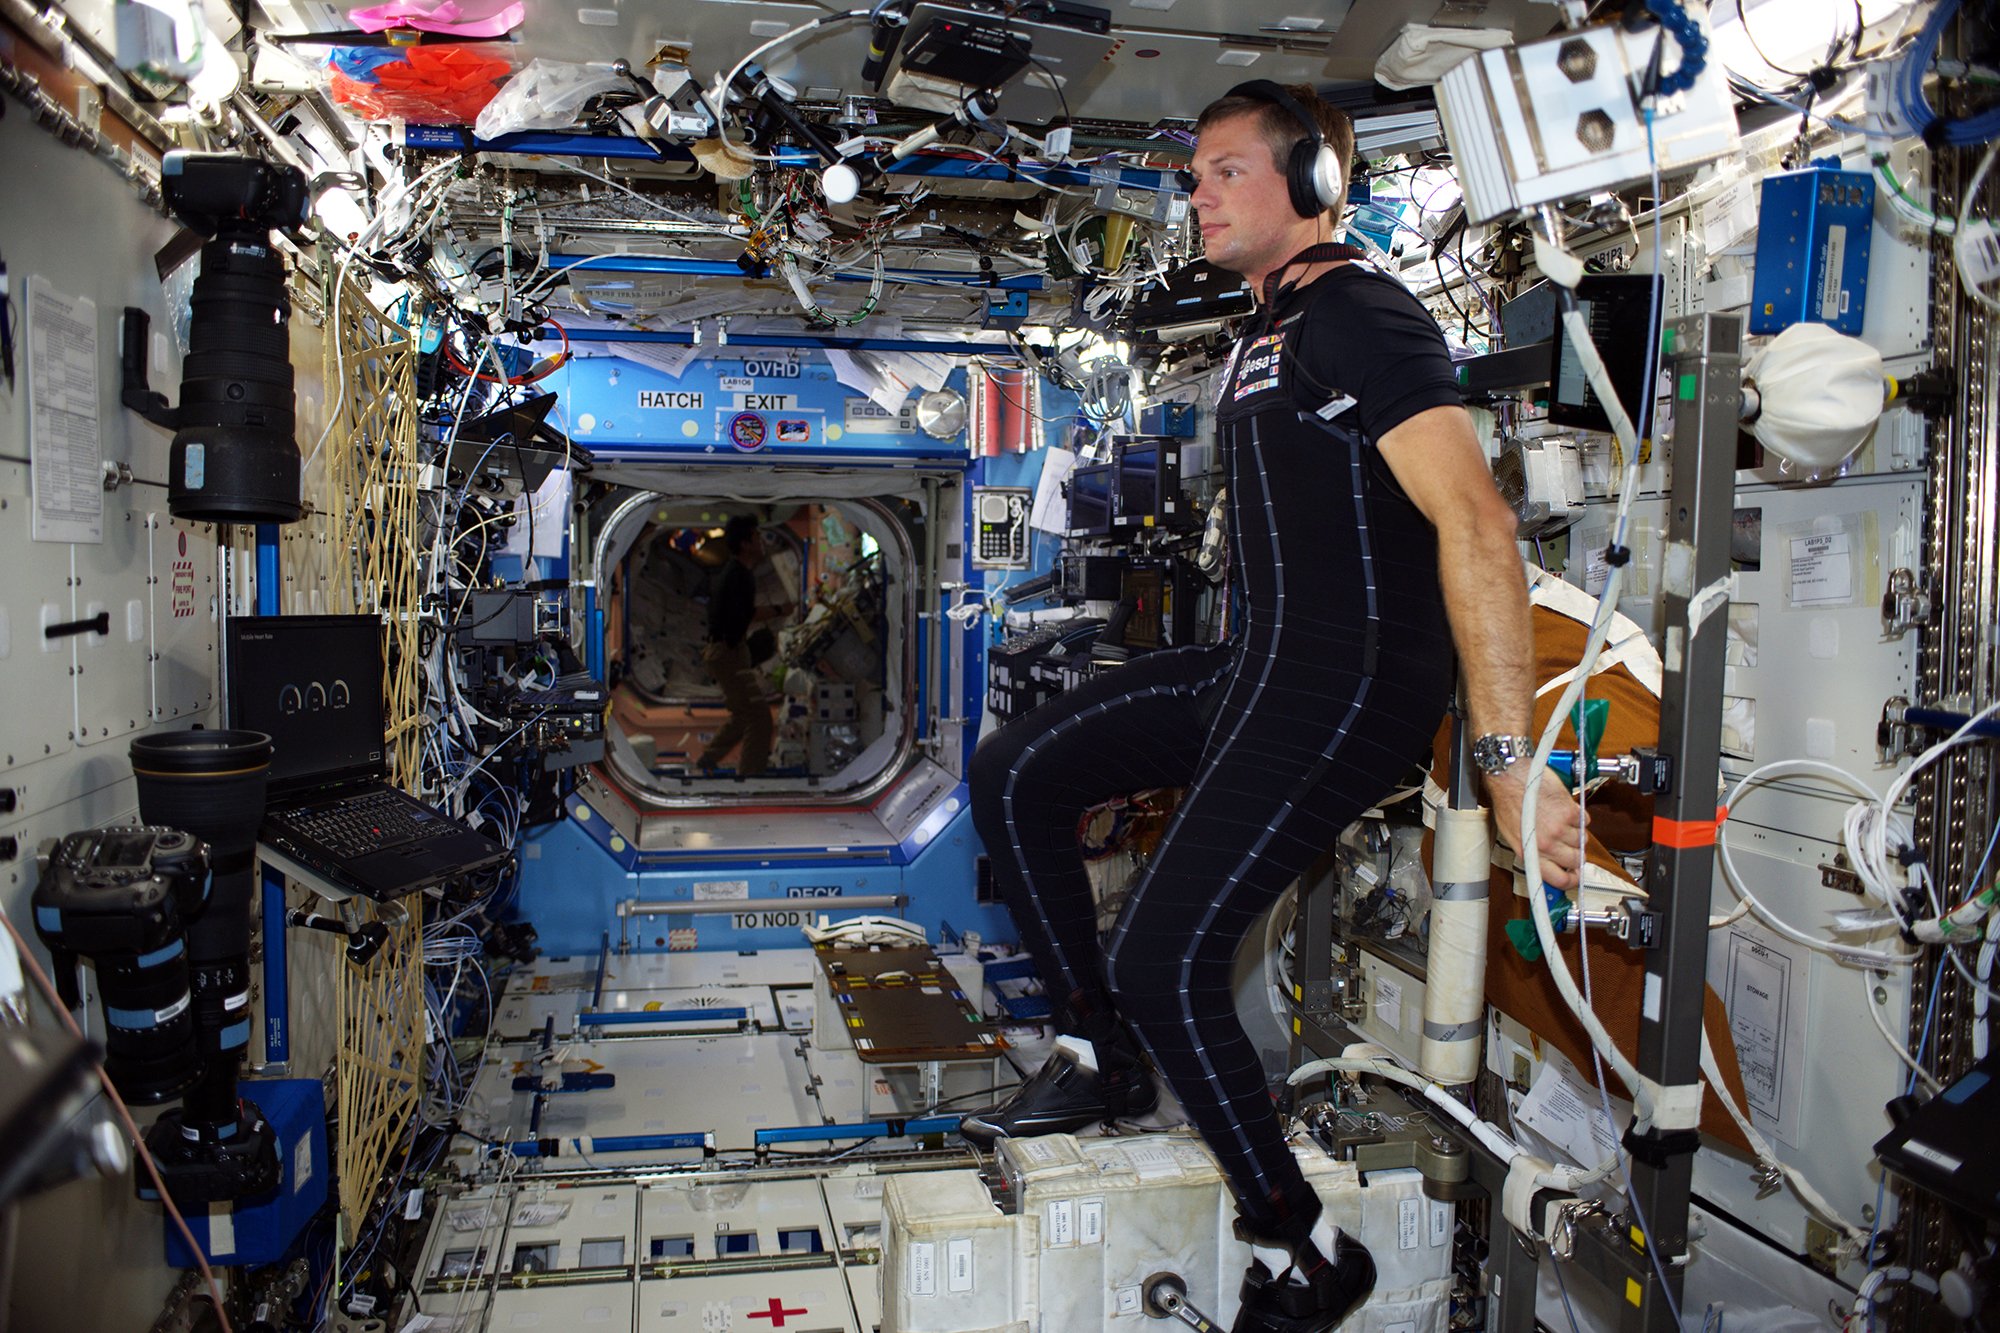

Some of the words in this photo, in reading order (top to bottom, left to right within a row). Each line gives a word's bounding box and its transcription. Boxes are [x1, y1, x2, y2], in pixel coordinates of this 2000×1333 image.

[1820, 243, 1828, 261] Supply
[745, 361, 799, 377] OVHD
[640, 392, 702, 408] HATCH
[744, 394, 787, 410] EXIT
[735, 913, 757, 929] TO
[763, 912, 799, 927] NOD
[805, 912, 812, 925] 1
[1746, 984, 1769, 1001] STOWAGE
